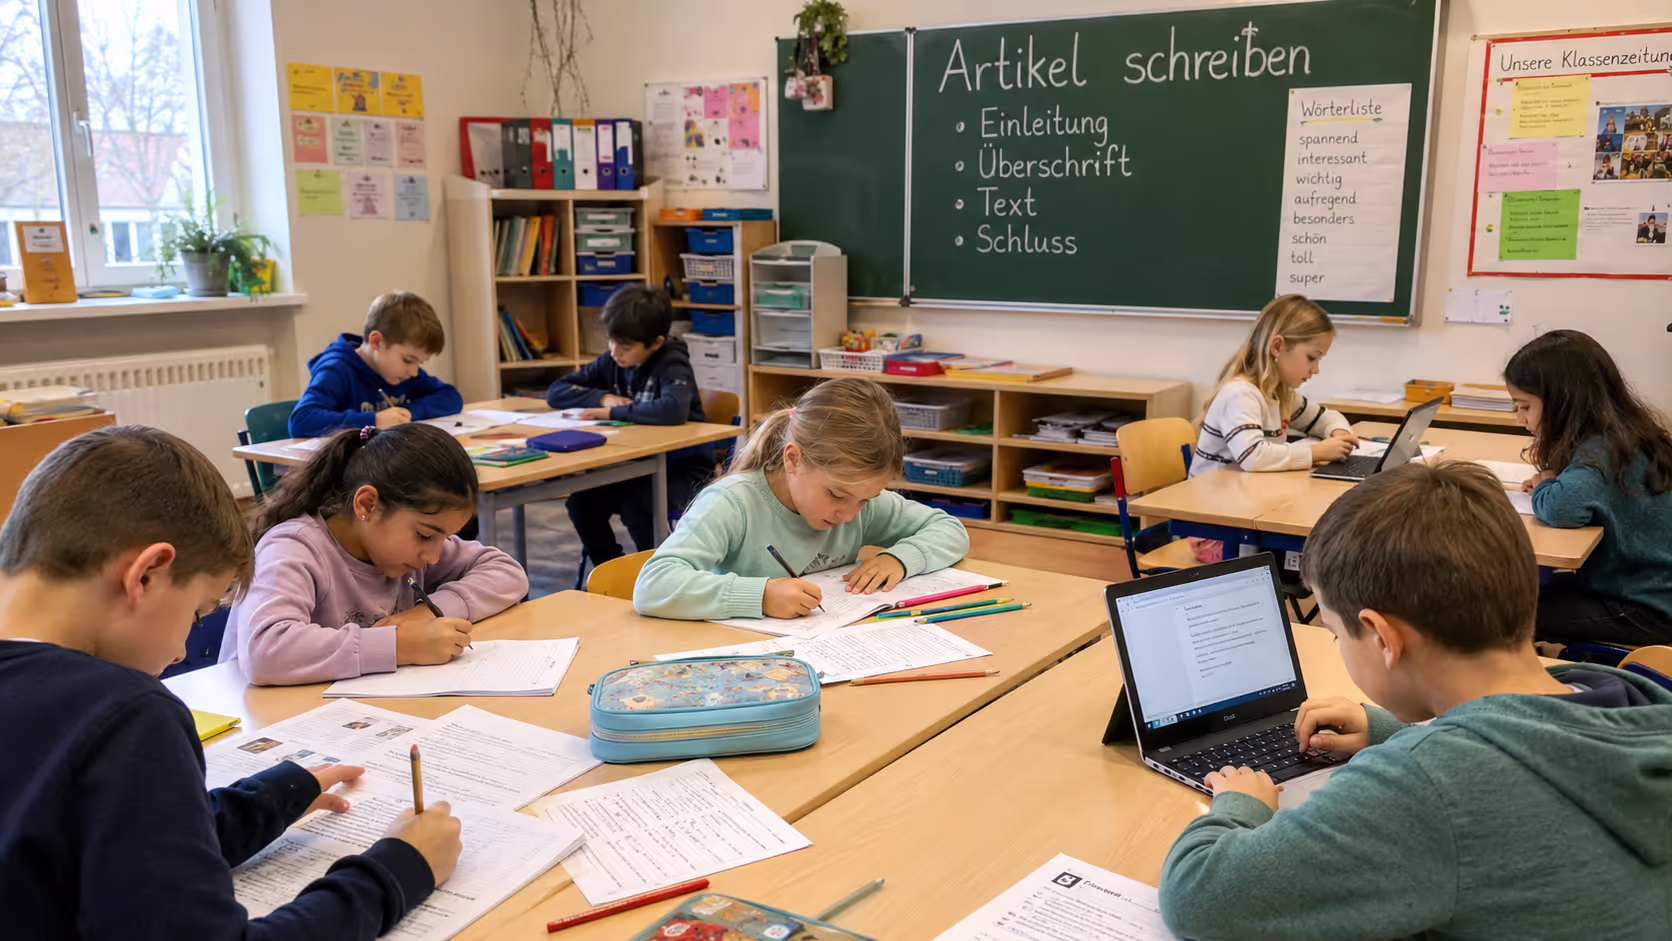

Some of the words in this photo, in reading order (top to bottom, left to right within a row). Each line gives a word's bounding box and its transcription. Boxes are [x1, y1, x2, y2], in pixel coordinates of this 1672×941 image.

[939, 32, 1086, 92] Artikel
[1124, 21, 1311, 84] schreiben
[1501, 54, 1552, 71] Unsere
[1562, 48, 1672, 68] Klassenzeitun
[1302, 99, 1381, 116] Wörterliste
[981, 105, 1109, 146] Einleitung
[1299, 131, 1358, 149] spannend
[978, 144, 1133, 178] Überschrift
[1298, 152, 1367, 164] interessant
[1296, 172, 1342, 189] wichtig
[977, 187, 1037, 216] Text
[1295, 191, 1356, 210] aufregend
[1294, 212, 1354, 224] besonders
[977, 224, 1077, 254] Schluss
[1293, 232, 1326, 244] schön
[1291, 251, 1314, 264] toll
[1290, 273, 1325, 287] super
